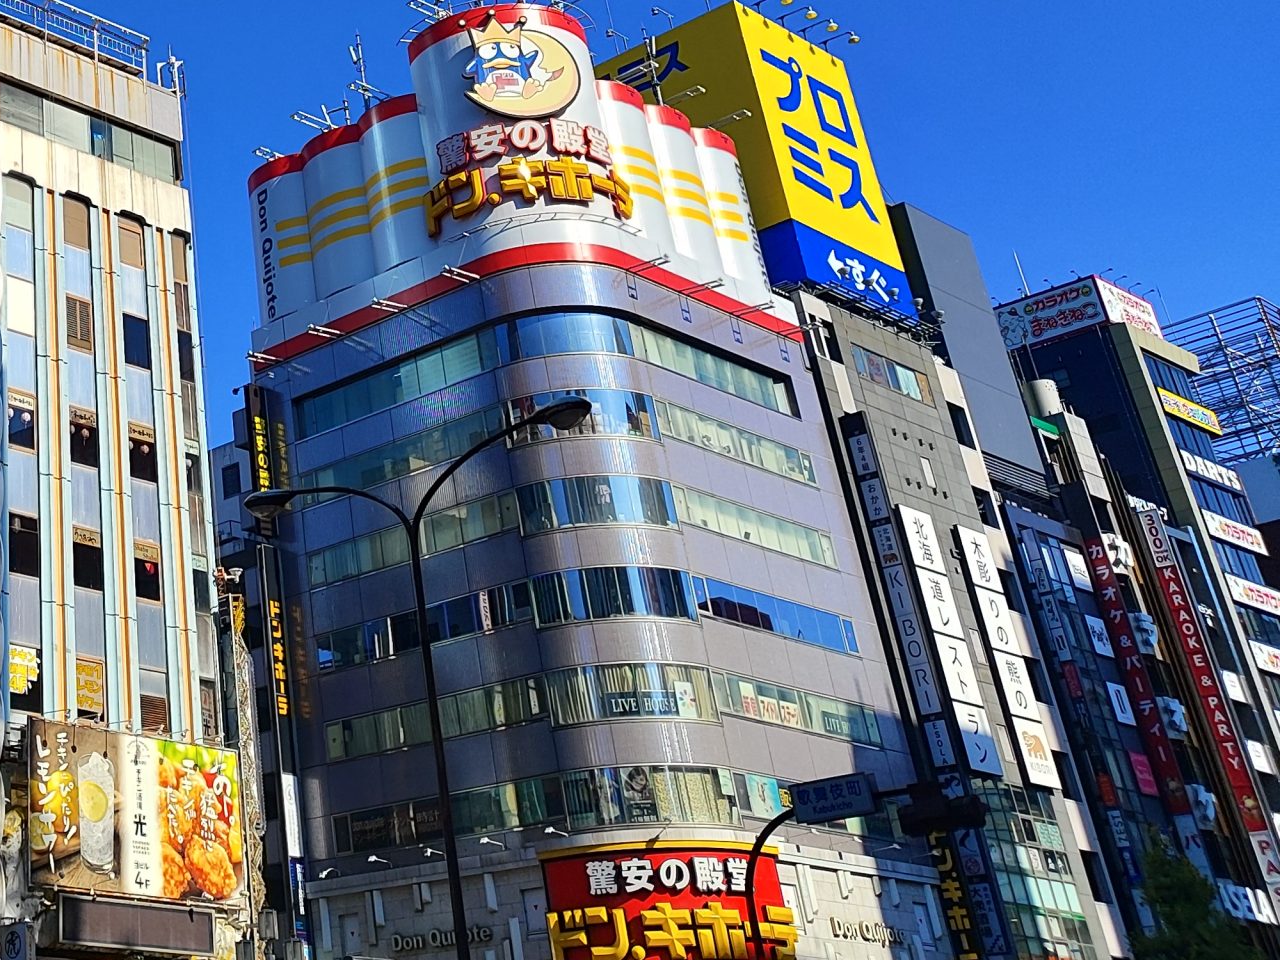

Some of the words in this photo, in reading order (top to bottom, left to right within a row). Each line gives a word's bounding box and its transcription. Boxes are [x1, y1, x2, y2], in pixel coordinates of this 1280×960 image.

[436, 118, 613, 175] 驚安の殿堂
[1180, 448, 1242, 492] DARTS
[867, 484, 882, 516] おかか
[1144, 514, 1164, 550] 300
[1156, 553, 1171, 564] OK
[1088, 543, 1125, 625] カラオケ
[889, 571, 931, 708] KIBORI
[1119, 634, 1134, 648] &
[1162, 567, 1206, 667] KARAOKE
[1200, 675, 1214, 687] &
[1208, 696, 1241, 771] PARTY
[611, 697, 639, 714] LIVE
[643, 695, 678, 714] HOUSE
[1124, 653, 1168, 763] パーティー
[931, 722, 950, 766] ESOLA
[35, 734, 58, 874] レモンサワー
[797, 780, 862, 806] 歌舞伎町
[812, 801, 854, 815] Kabukicho
[133, 813, 147, 838] 光
[134, 871, 151, 890] 4F
[586, 856, 750, 896] 驚安の殿堂
[391, 933, 424, 952] Don
[427, 925, 494, 948] Quiote
[830, 917, 858, 940] Don
